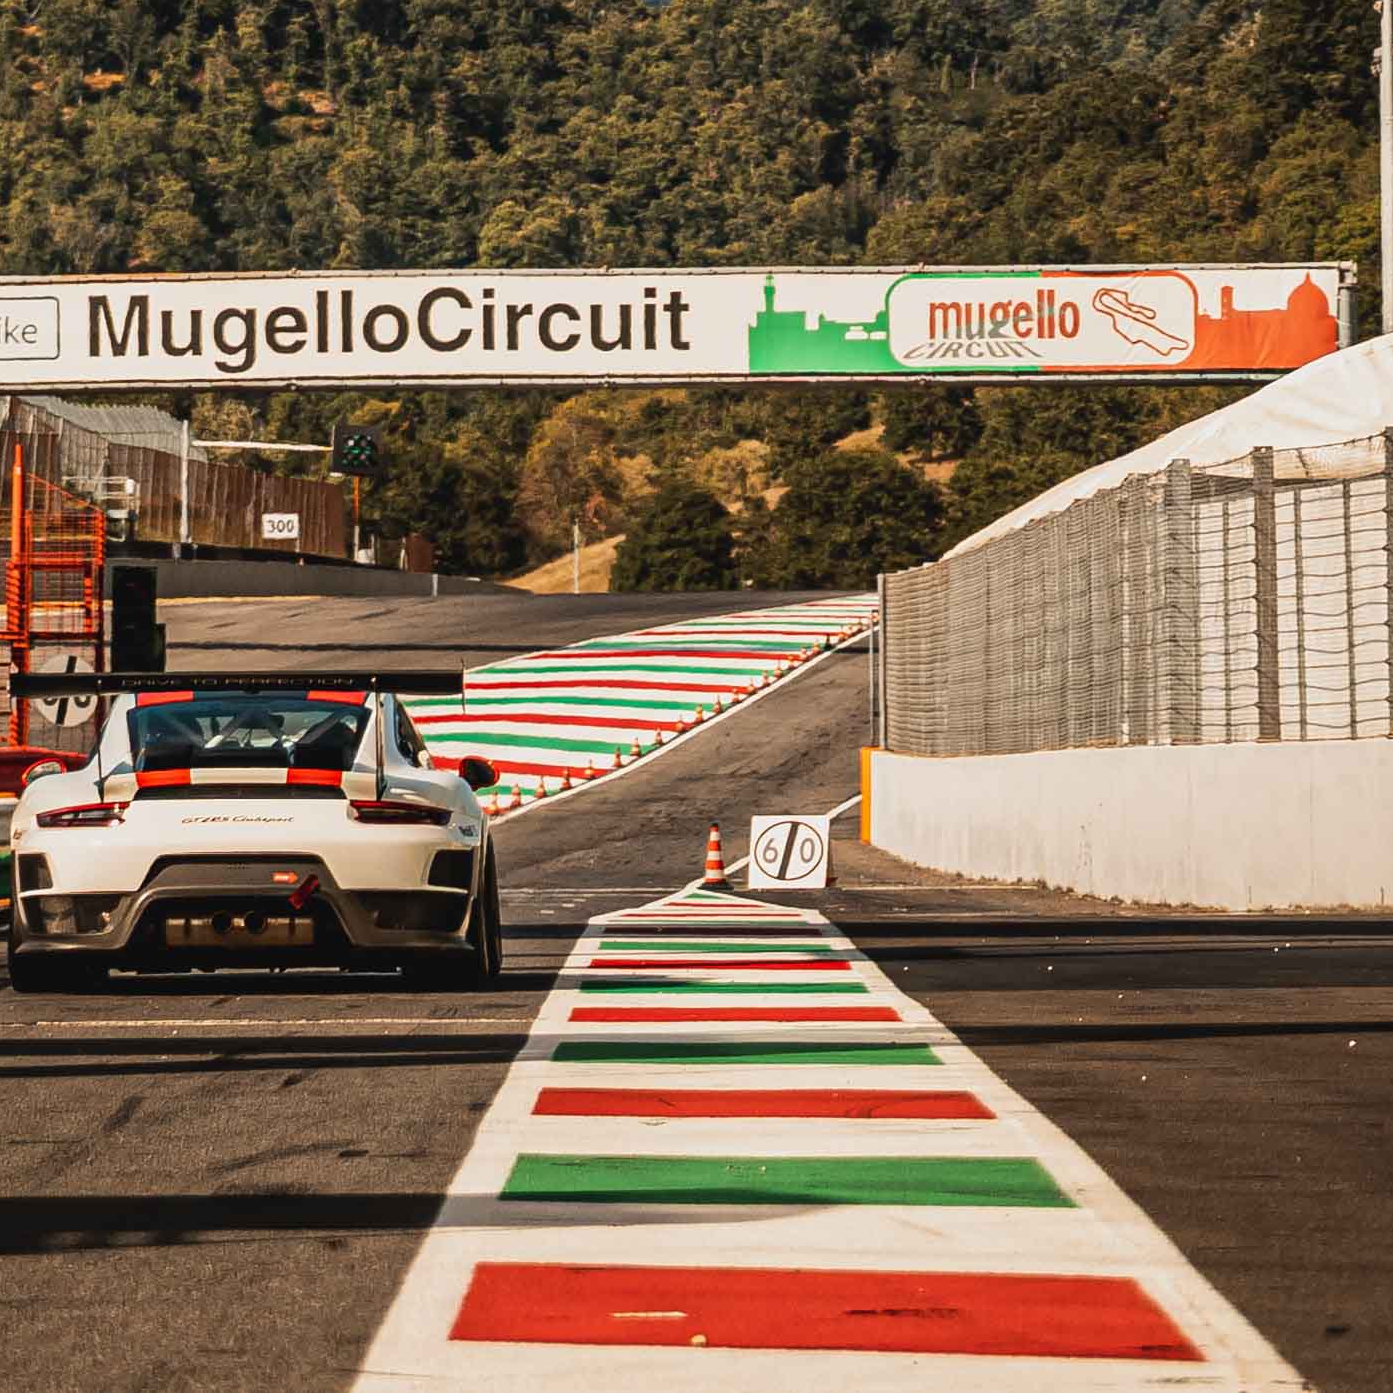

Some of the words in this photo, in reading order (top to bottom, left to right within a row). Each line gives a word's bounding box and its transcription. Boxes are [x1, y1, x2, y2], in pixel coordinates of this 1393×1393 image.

[87, 286, 691, 373] MugelloCircuit
[928, 288, 1081, 340] mugello
[903, 340, 1044, 360] CIRCUIT
[267, 519, 295, 533] 300
